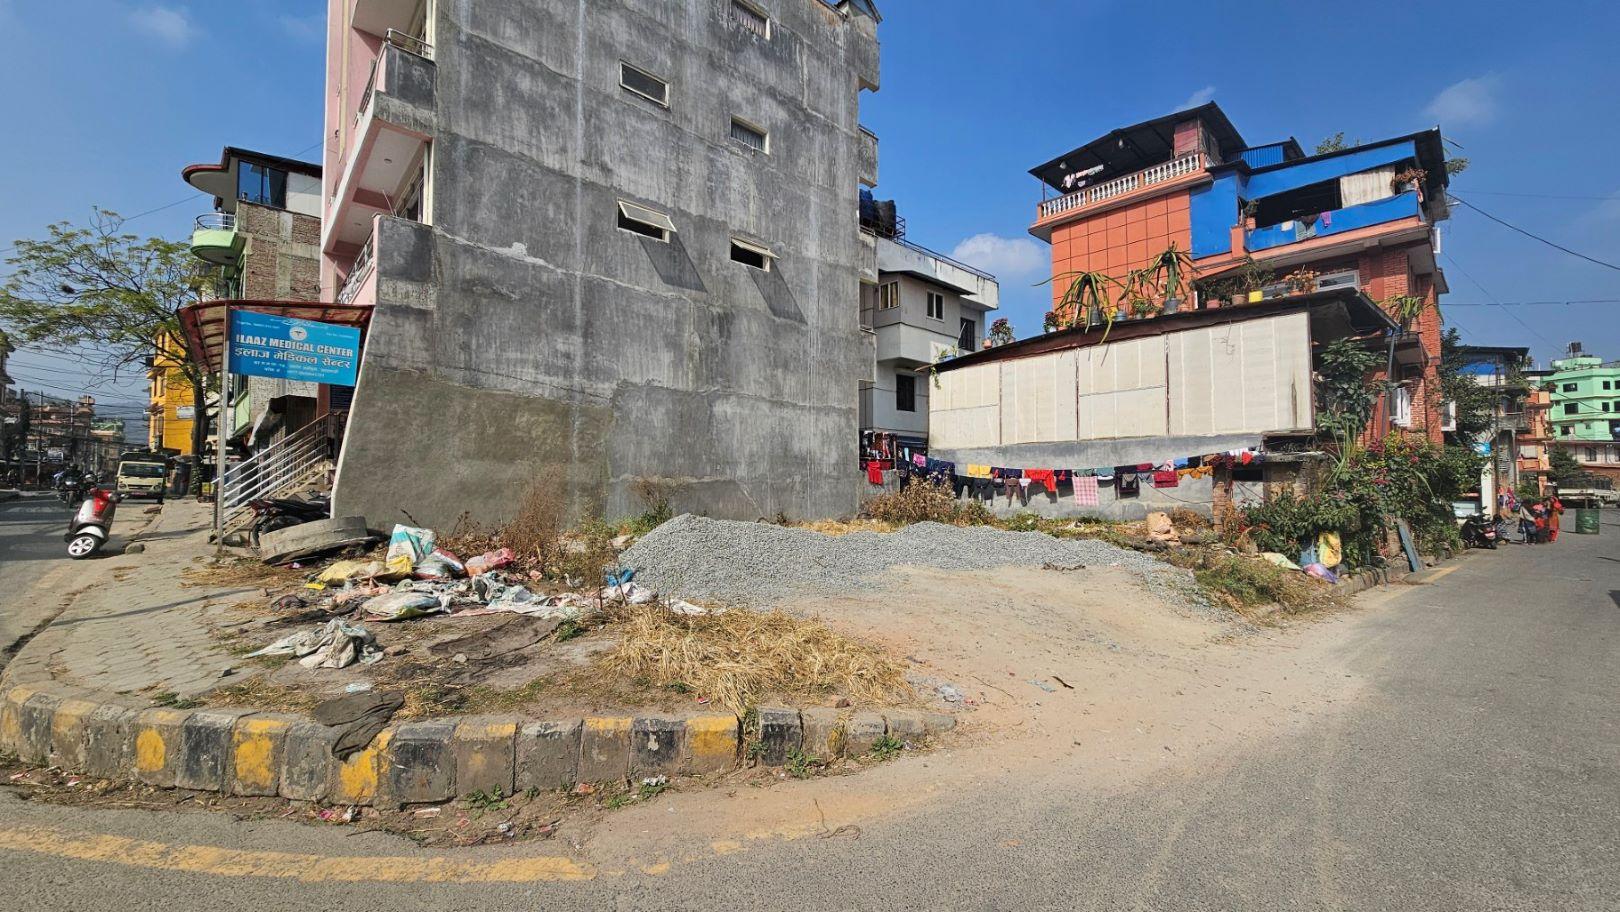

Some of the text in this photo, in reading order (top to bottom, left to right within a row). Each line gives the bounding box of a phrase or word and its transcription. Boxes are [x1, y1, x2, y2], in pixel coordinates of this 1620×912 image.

[234, 347, 270, 359] इलाज
[273, 349, 318, 364] मेडिकल
[235, 334, 353, 357] ILAAZ MEDICAL CENTER
